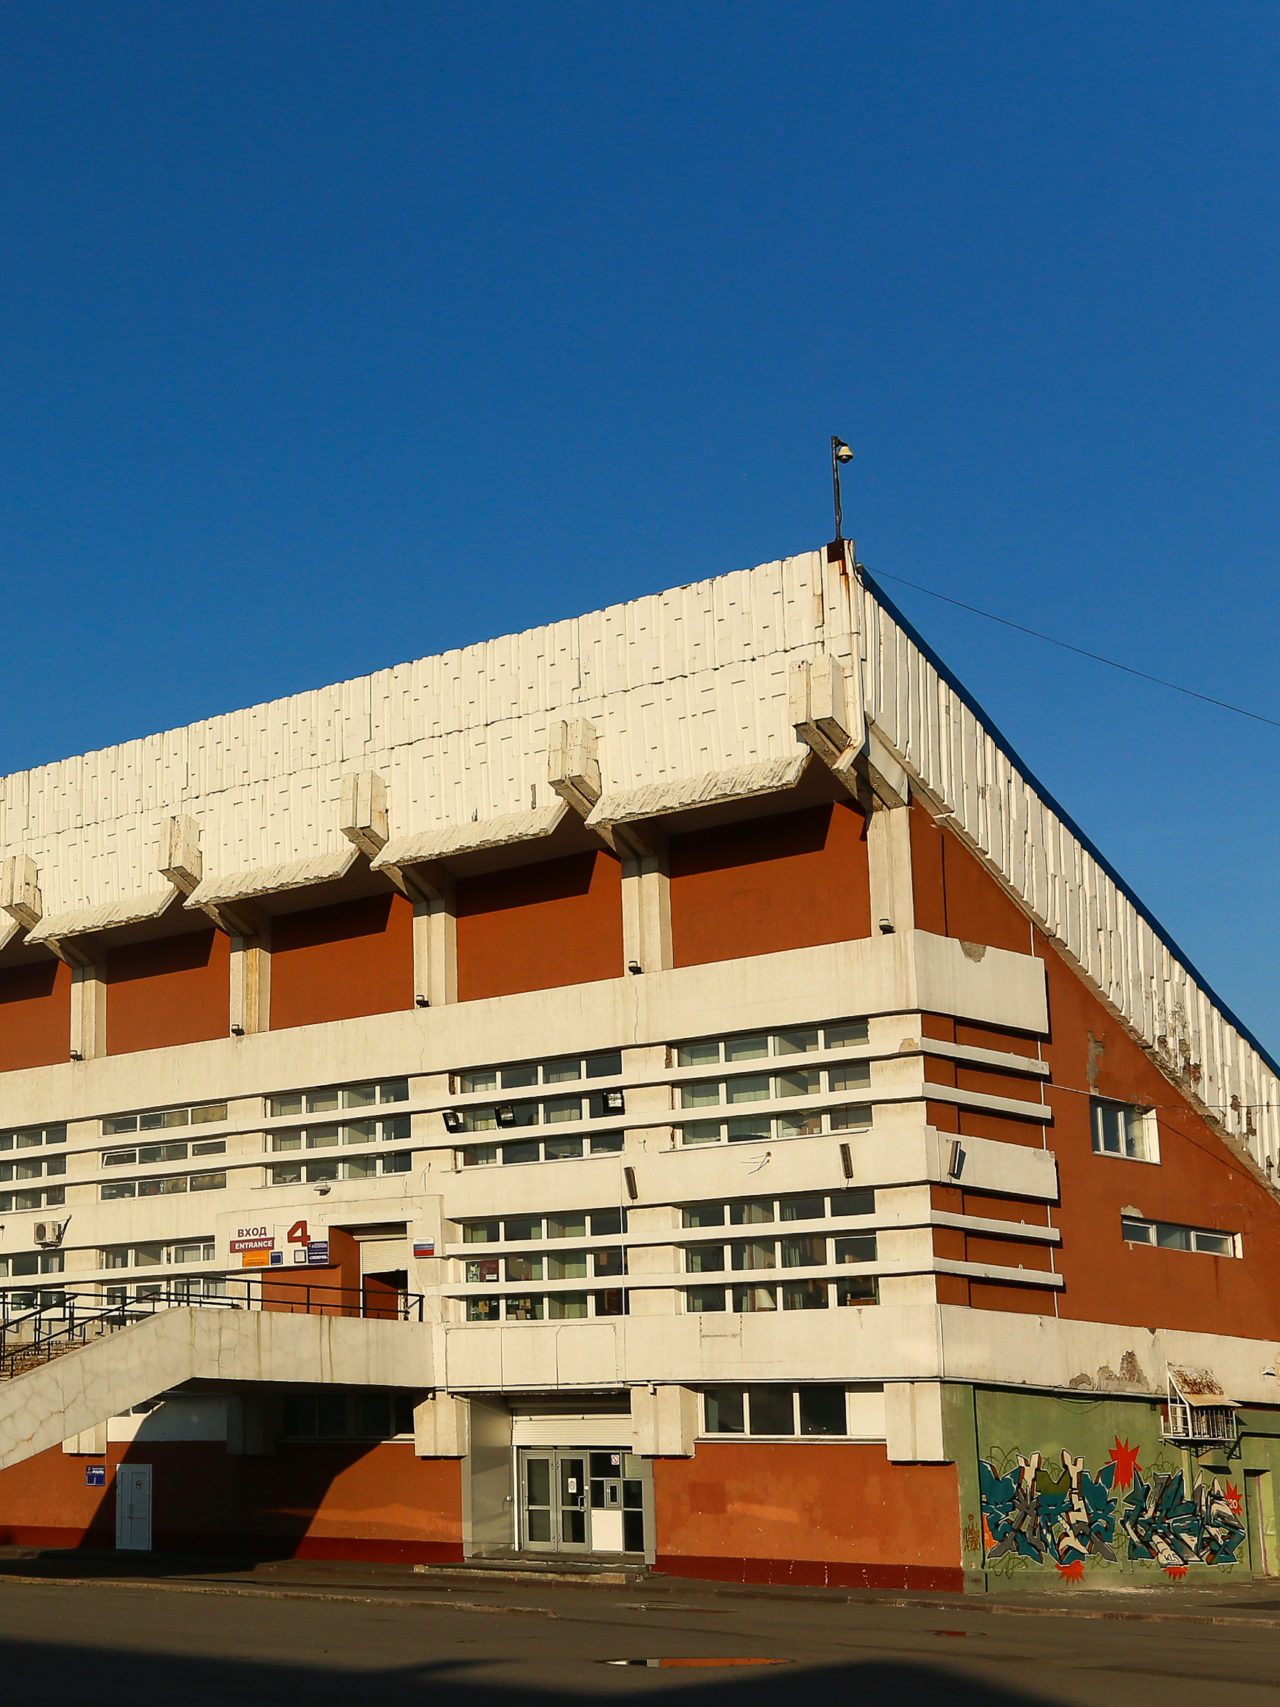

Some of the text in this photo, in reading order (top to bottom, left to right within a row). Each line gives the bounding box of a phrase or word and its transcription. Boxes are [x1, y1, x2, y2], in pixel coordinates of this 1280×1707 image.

[238, 1226, 267, 1238] ВХОД
[287, 1220, 310, 1247] 4
[235, 1239, 273, 1250] ENTRANCE
